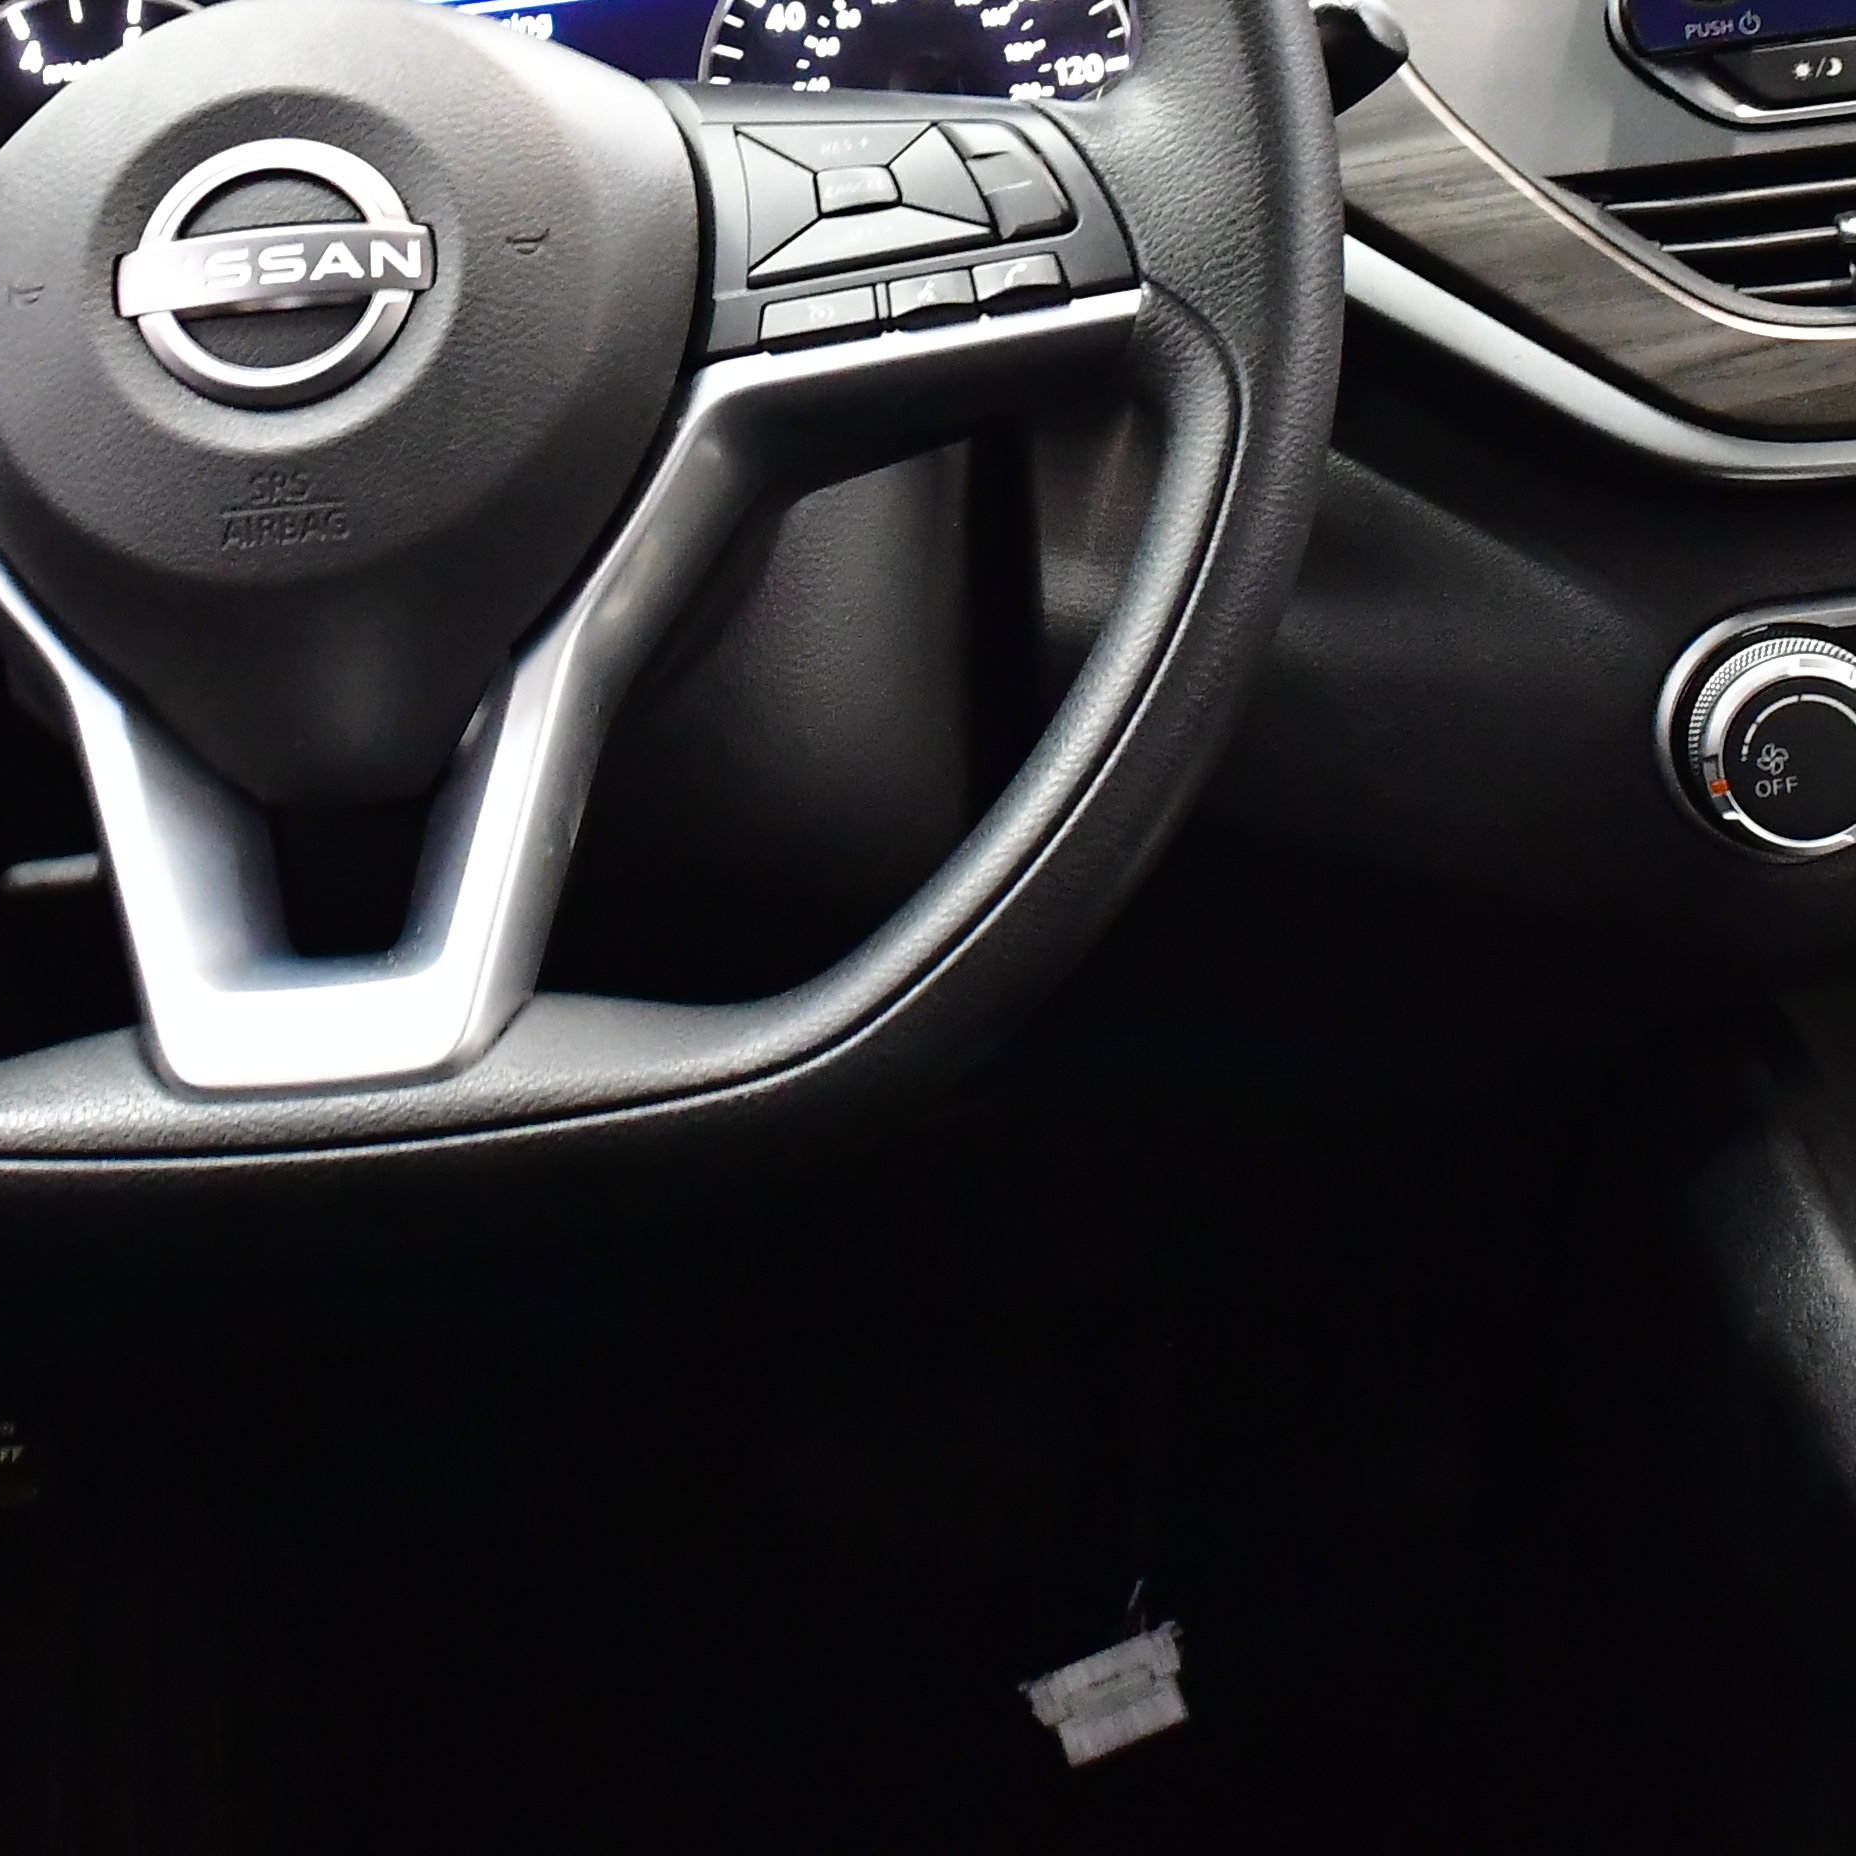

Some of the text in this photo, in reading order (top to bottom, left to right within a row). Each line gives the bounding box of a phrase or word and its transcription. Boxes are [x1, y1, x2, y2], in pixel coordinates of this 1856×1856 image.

[766, 1, 806, 32] 40
[1685, 19, 1734, 41] PUSH
[20, 40, 43, 73] 4
[1054, 53, 1104, 86] 120
[142, 239, 422, 291] SSAN
[220, 508, 351, 552] AIRBAG
[1755, 776, 1799, 799] OFF
